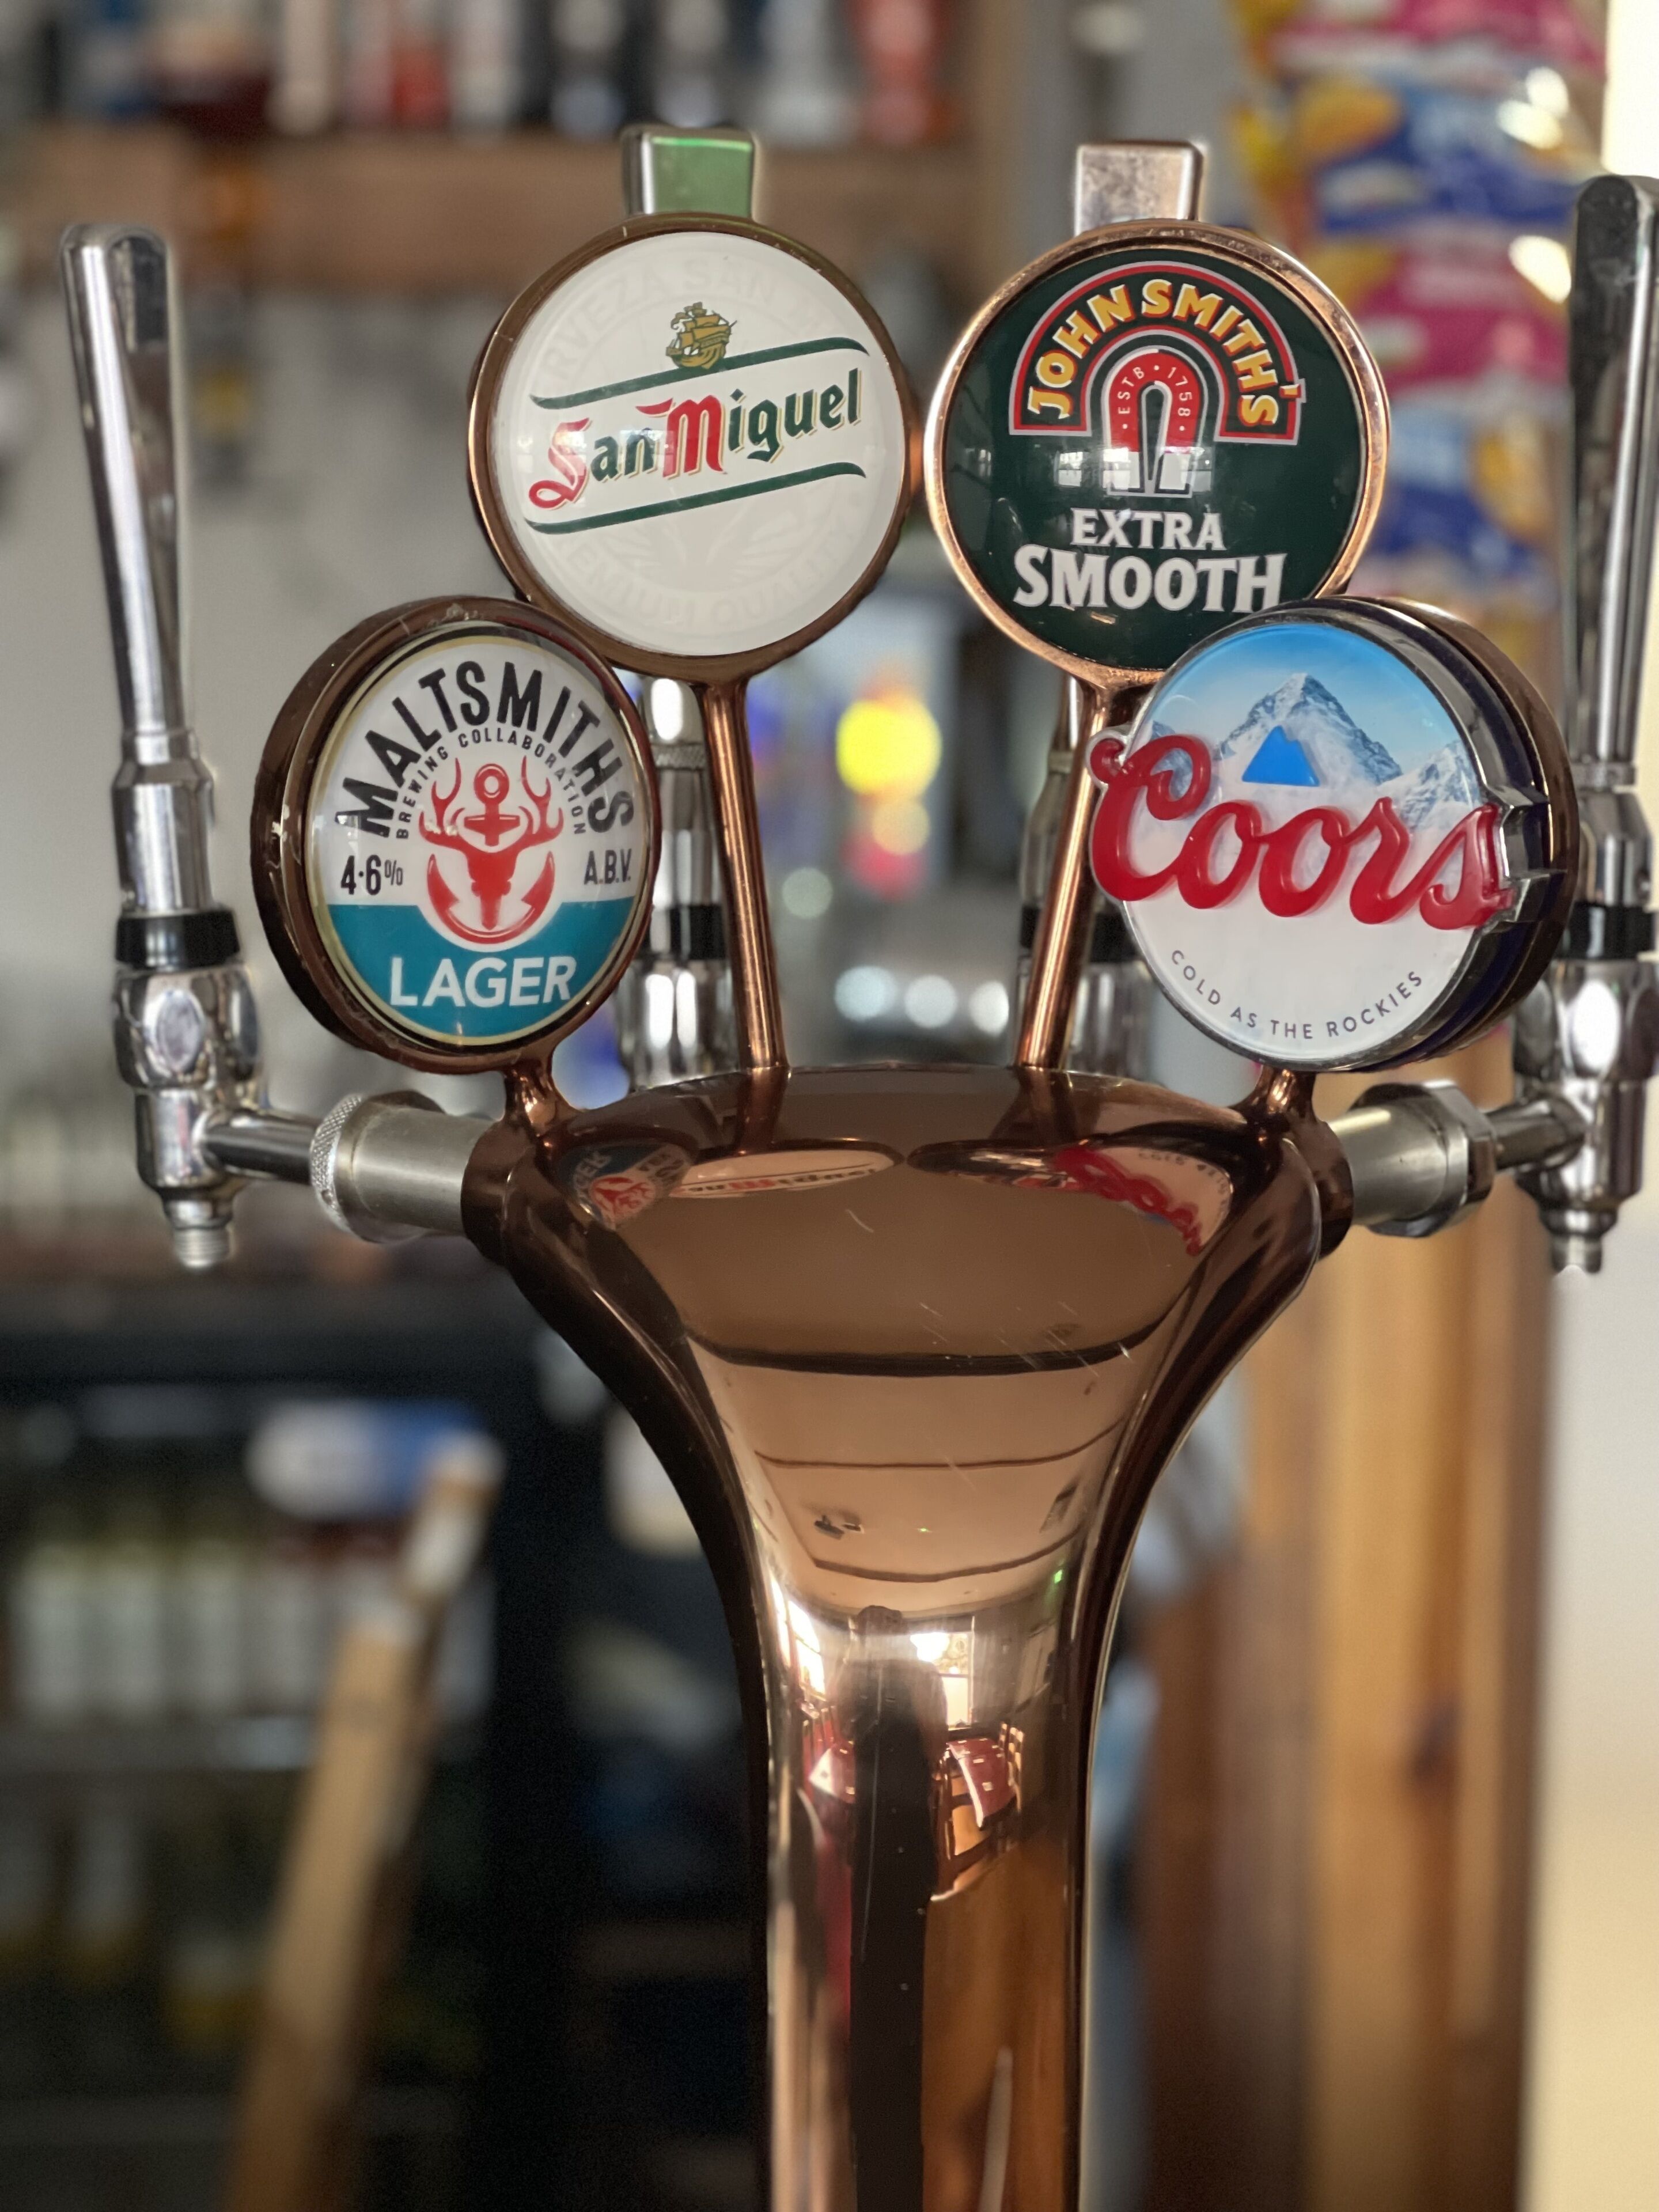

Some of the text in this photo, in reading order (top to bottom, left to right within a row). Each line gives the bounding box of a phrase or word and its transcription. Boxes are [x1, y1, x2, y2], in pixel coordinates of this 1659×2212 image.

[1028, 279, 1302, 426] JOHN SMITH'S
[1118, 367, 1192, 416] ESTB 1758
[1071, 507, 1227, 551] EXTRA
[1013, 544, 1288, 614] SMOOTH
[335, 661, 634, 838] MALTSMITHS
[396, 728, 586, 839] BREWING COLLABORATION
[1090, 734, 1514, 930] Coors
[390, 956, 576, 1007] LAGER
[1172, 950, 1422, 1039] COLD AS THE ROCKIES
